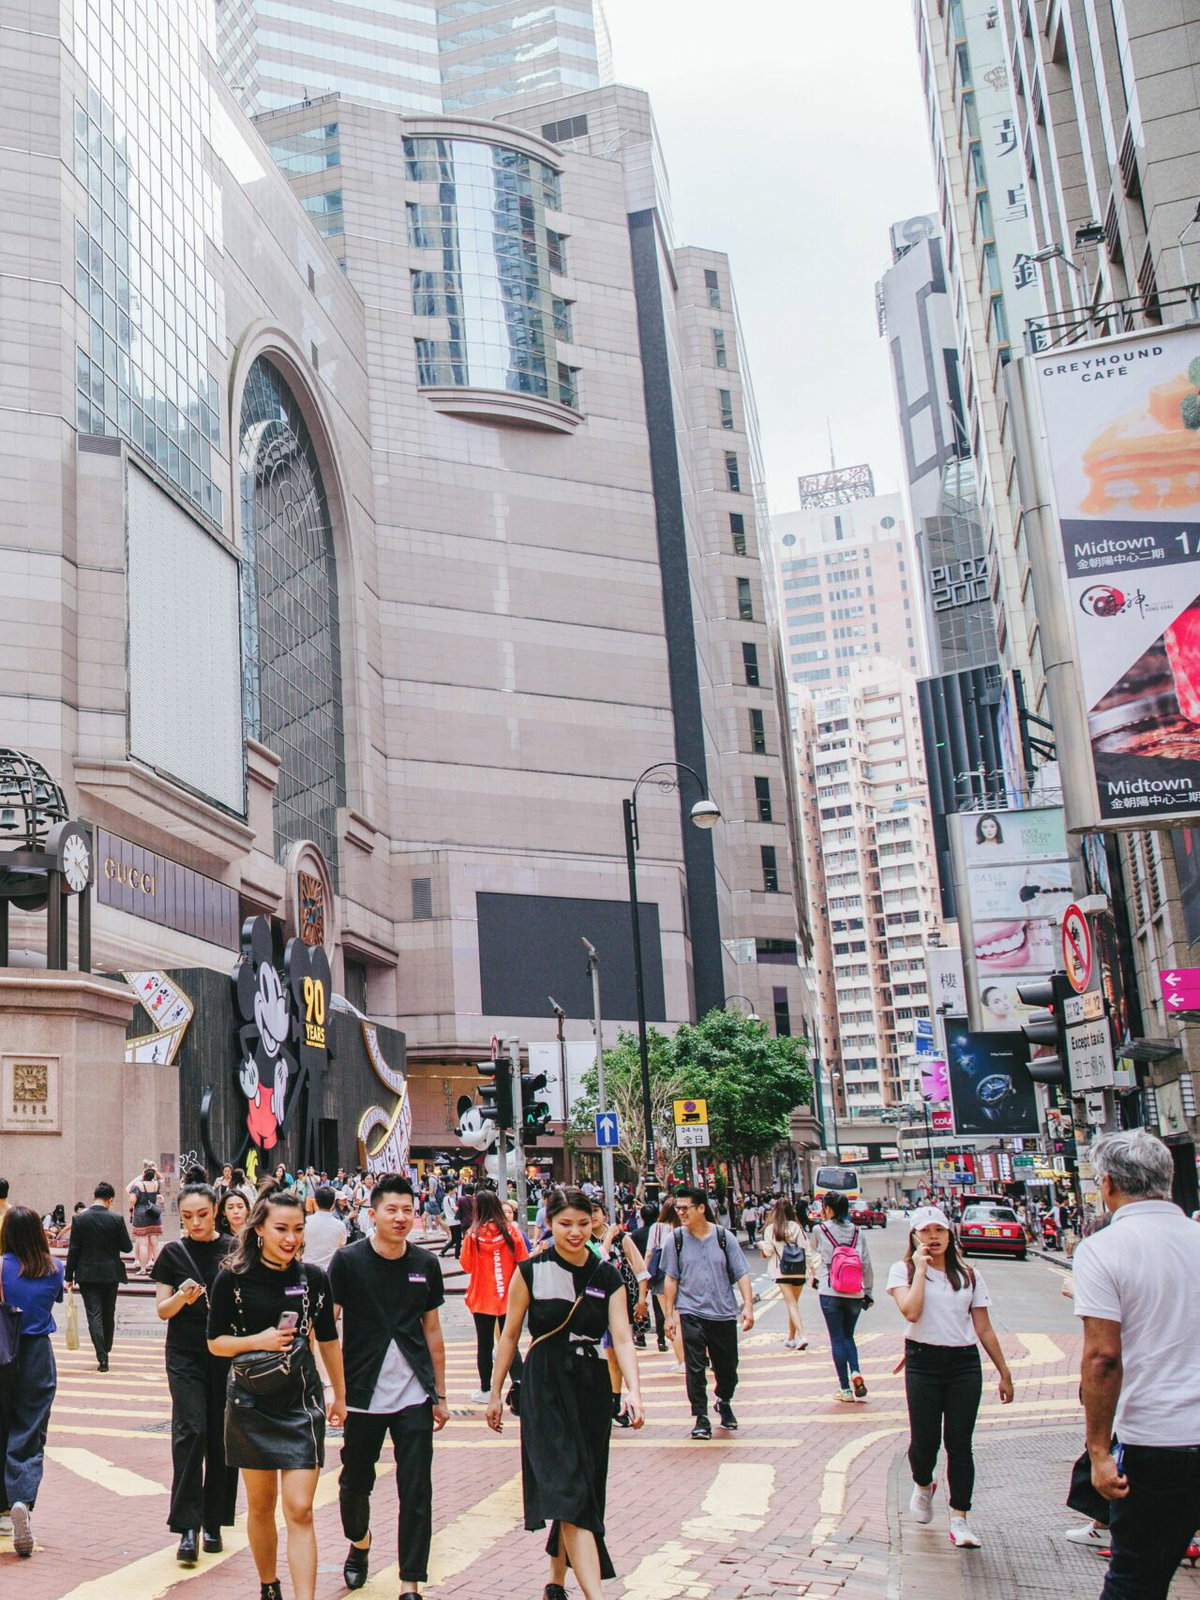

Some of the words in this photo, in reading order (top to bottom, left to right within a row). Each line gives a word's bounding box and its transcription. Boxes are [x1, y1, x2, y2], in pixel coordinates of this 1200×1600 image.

[1043, 346, 1163, 377] GREYHOUND
[1081, 365, 1128, 383] CAFÉ
[1073, 534, 1155, 558] Midtown
[1076, 548, 1165, 569] 金朝陽中心二期
[1107, 777, 1192, 796] Midtown
[104, 856, 156, 897] GUCCI
[303, 976, 325, 1025] 90
[305, 1023, 325, 1043] YEARS
[1071, 1035, 1091, 1051] Except
[1091, 1031, 1105, 1047] taxis
[683, 1135, 704, 1145] 全日
